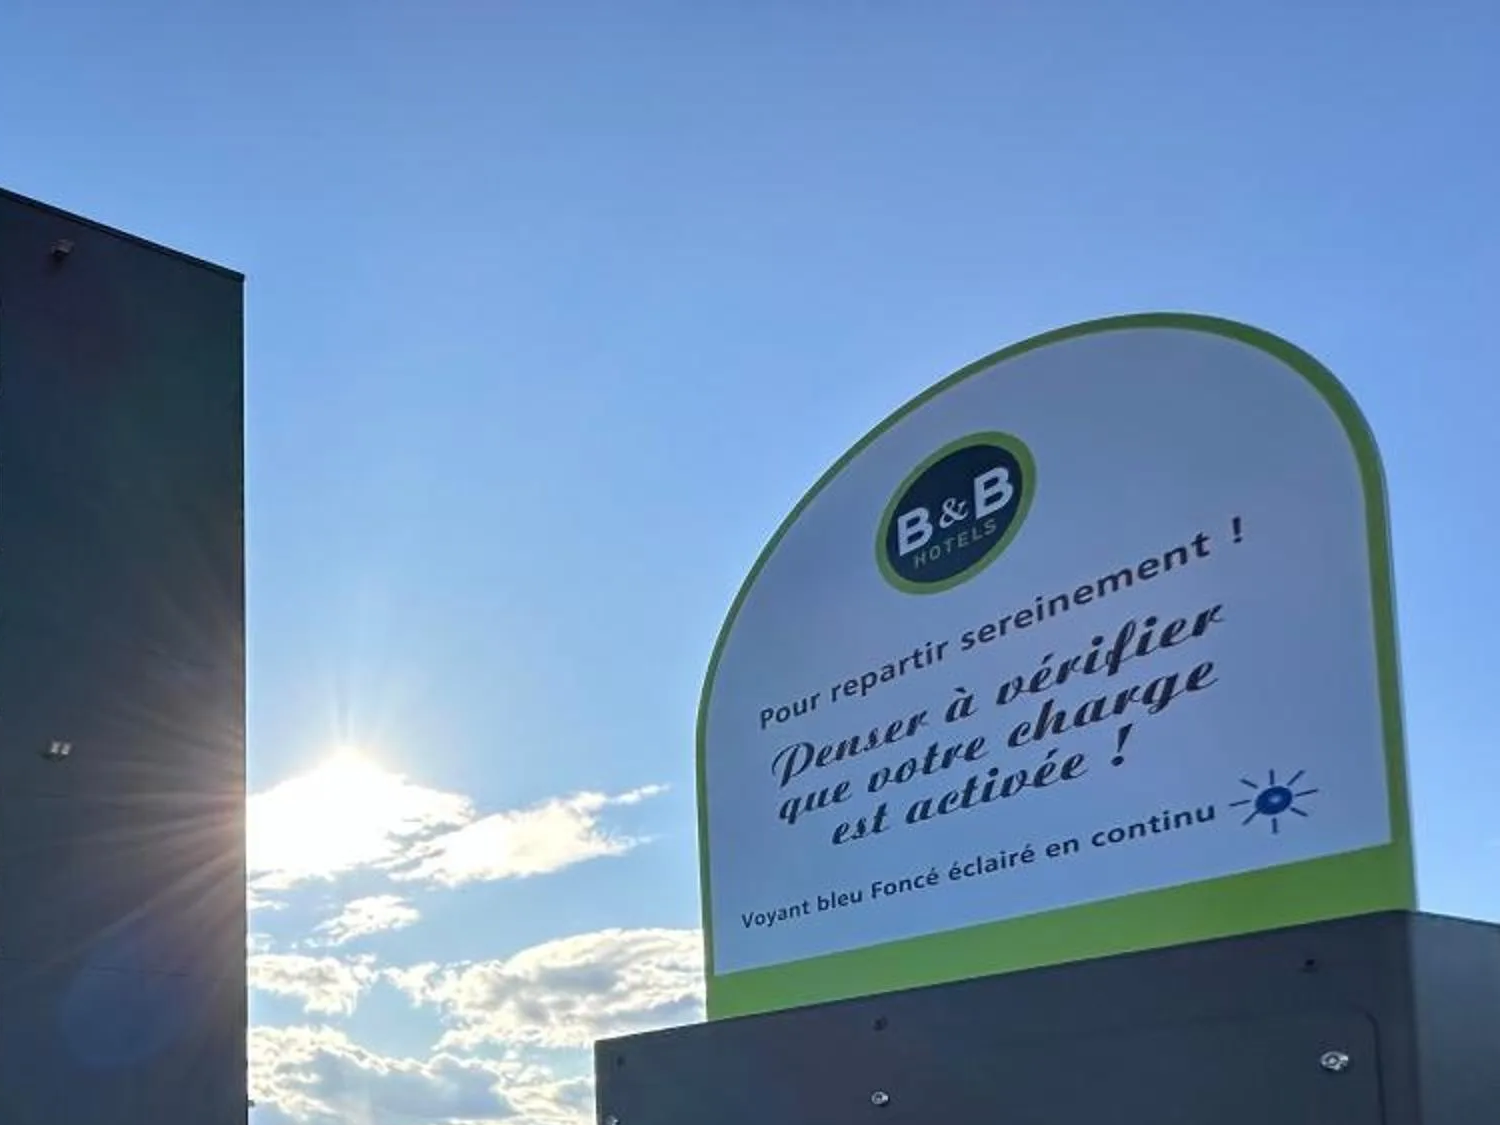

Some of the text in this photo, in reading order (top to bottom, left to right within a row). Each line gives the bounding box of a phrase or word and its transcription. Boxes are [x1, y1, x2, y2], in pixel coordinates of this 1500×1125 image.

[897, 467, 1013, 557] B&B
[913, 518, 997, 569] HOTELS
[760, 692, 821, 731] Pour
[831, 641, 949, 703] repartir
[961, 531, 1210, 652] sereinement
[771, 604, 1228, 788] Penser à vérifier
[779, 661, 1220, 825] que votre charge
[832, 802, 890, 845] est
[906, 748, 1089, 825] activée
[741, 804, 1216, 929] Voyant bleu Foncé éclairé en continu
